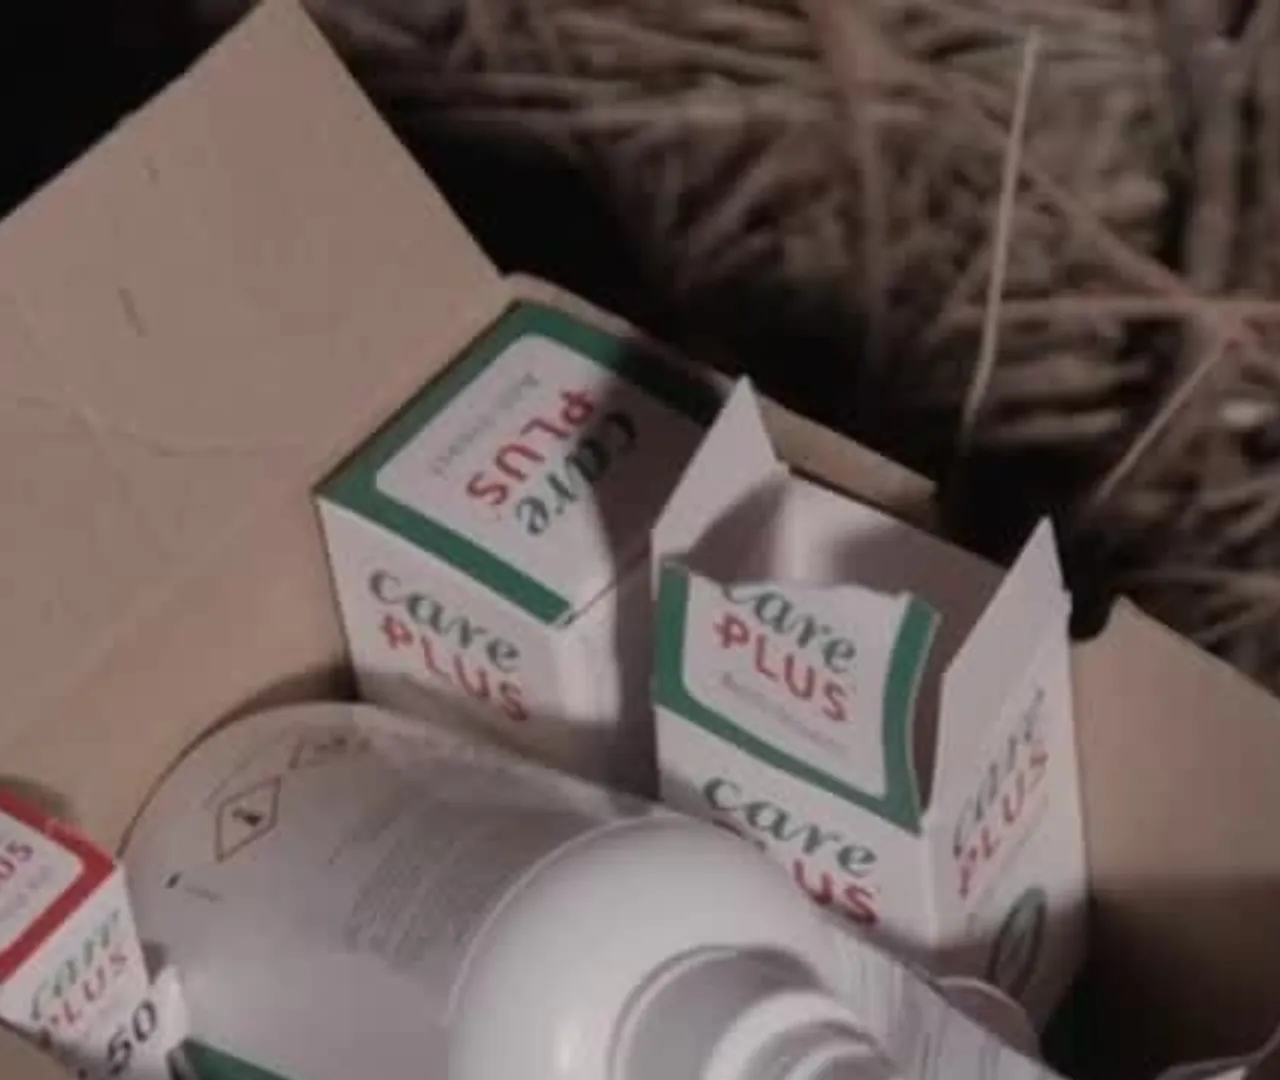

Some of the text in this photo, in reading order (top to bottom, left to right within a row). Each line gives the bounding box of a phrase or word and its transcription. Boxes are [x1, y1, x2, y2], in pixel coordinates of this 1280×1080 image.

[467, 388, 596, 506] PLUS
[517, 412, 637, 535] care
[370, 570, 520, 673] care
[381, 614, 528, 722] PLUS
[714, 612, 848, 722] PLUS
[703, 777, 877, 879] care
